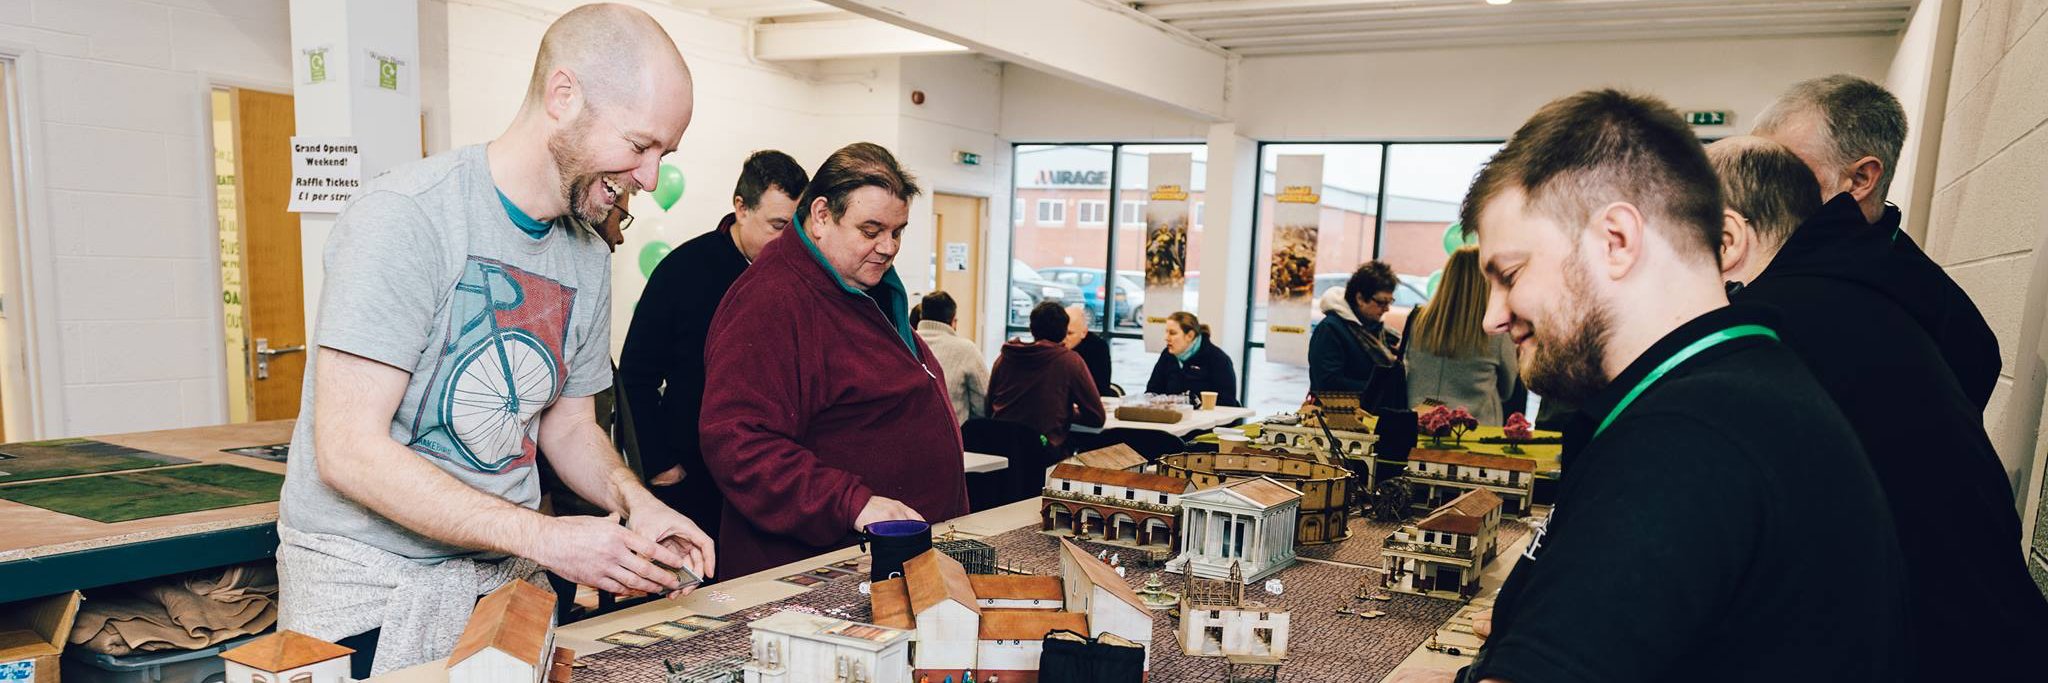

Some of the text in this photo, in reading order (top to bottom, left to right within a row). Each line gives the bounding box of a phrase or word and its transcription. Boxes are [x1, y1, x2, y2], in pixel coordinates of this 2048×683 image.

[295, 144, 358, 154] Grand Opening
[306, 158, 348, 166] Weekend!
[296, 177, 359, 187] Raffle Tickets
[1034, 170, 1108, 185] MIRAGE
[298, 191, 309, 200] £1
[312, 193, 329, 202] per
